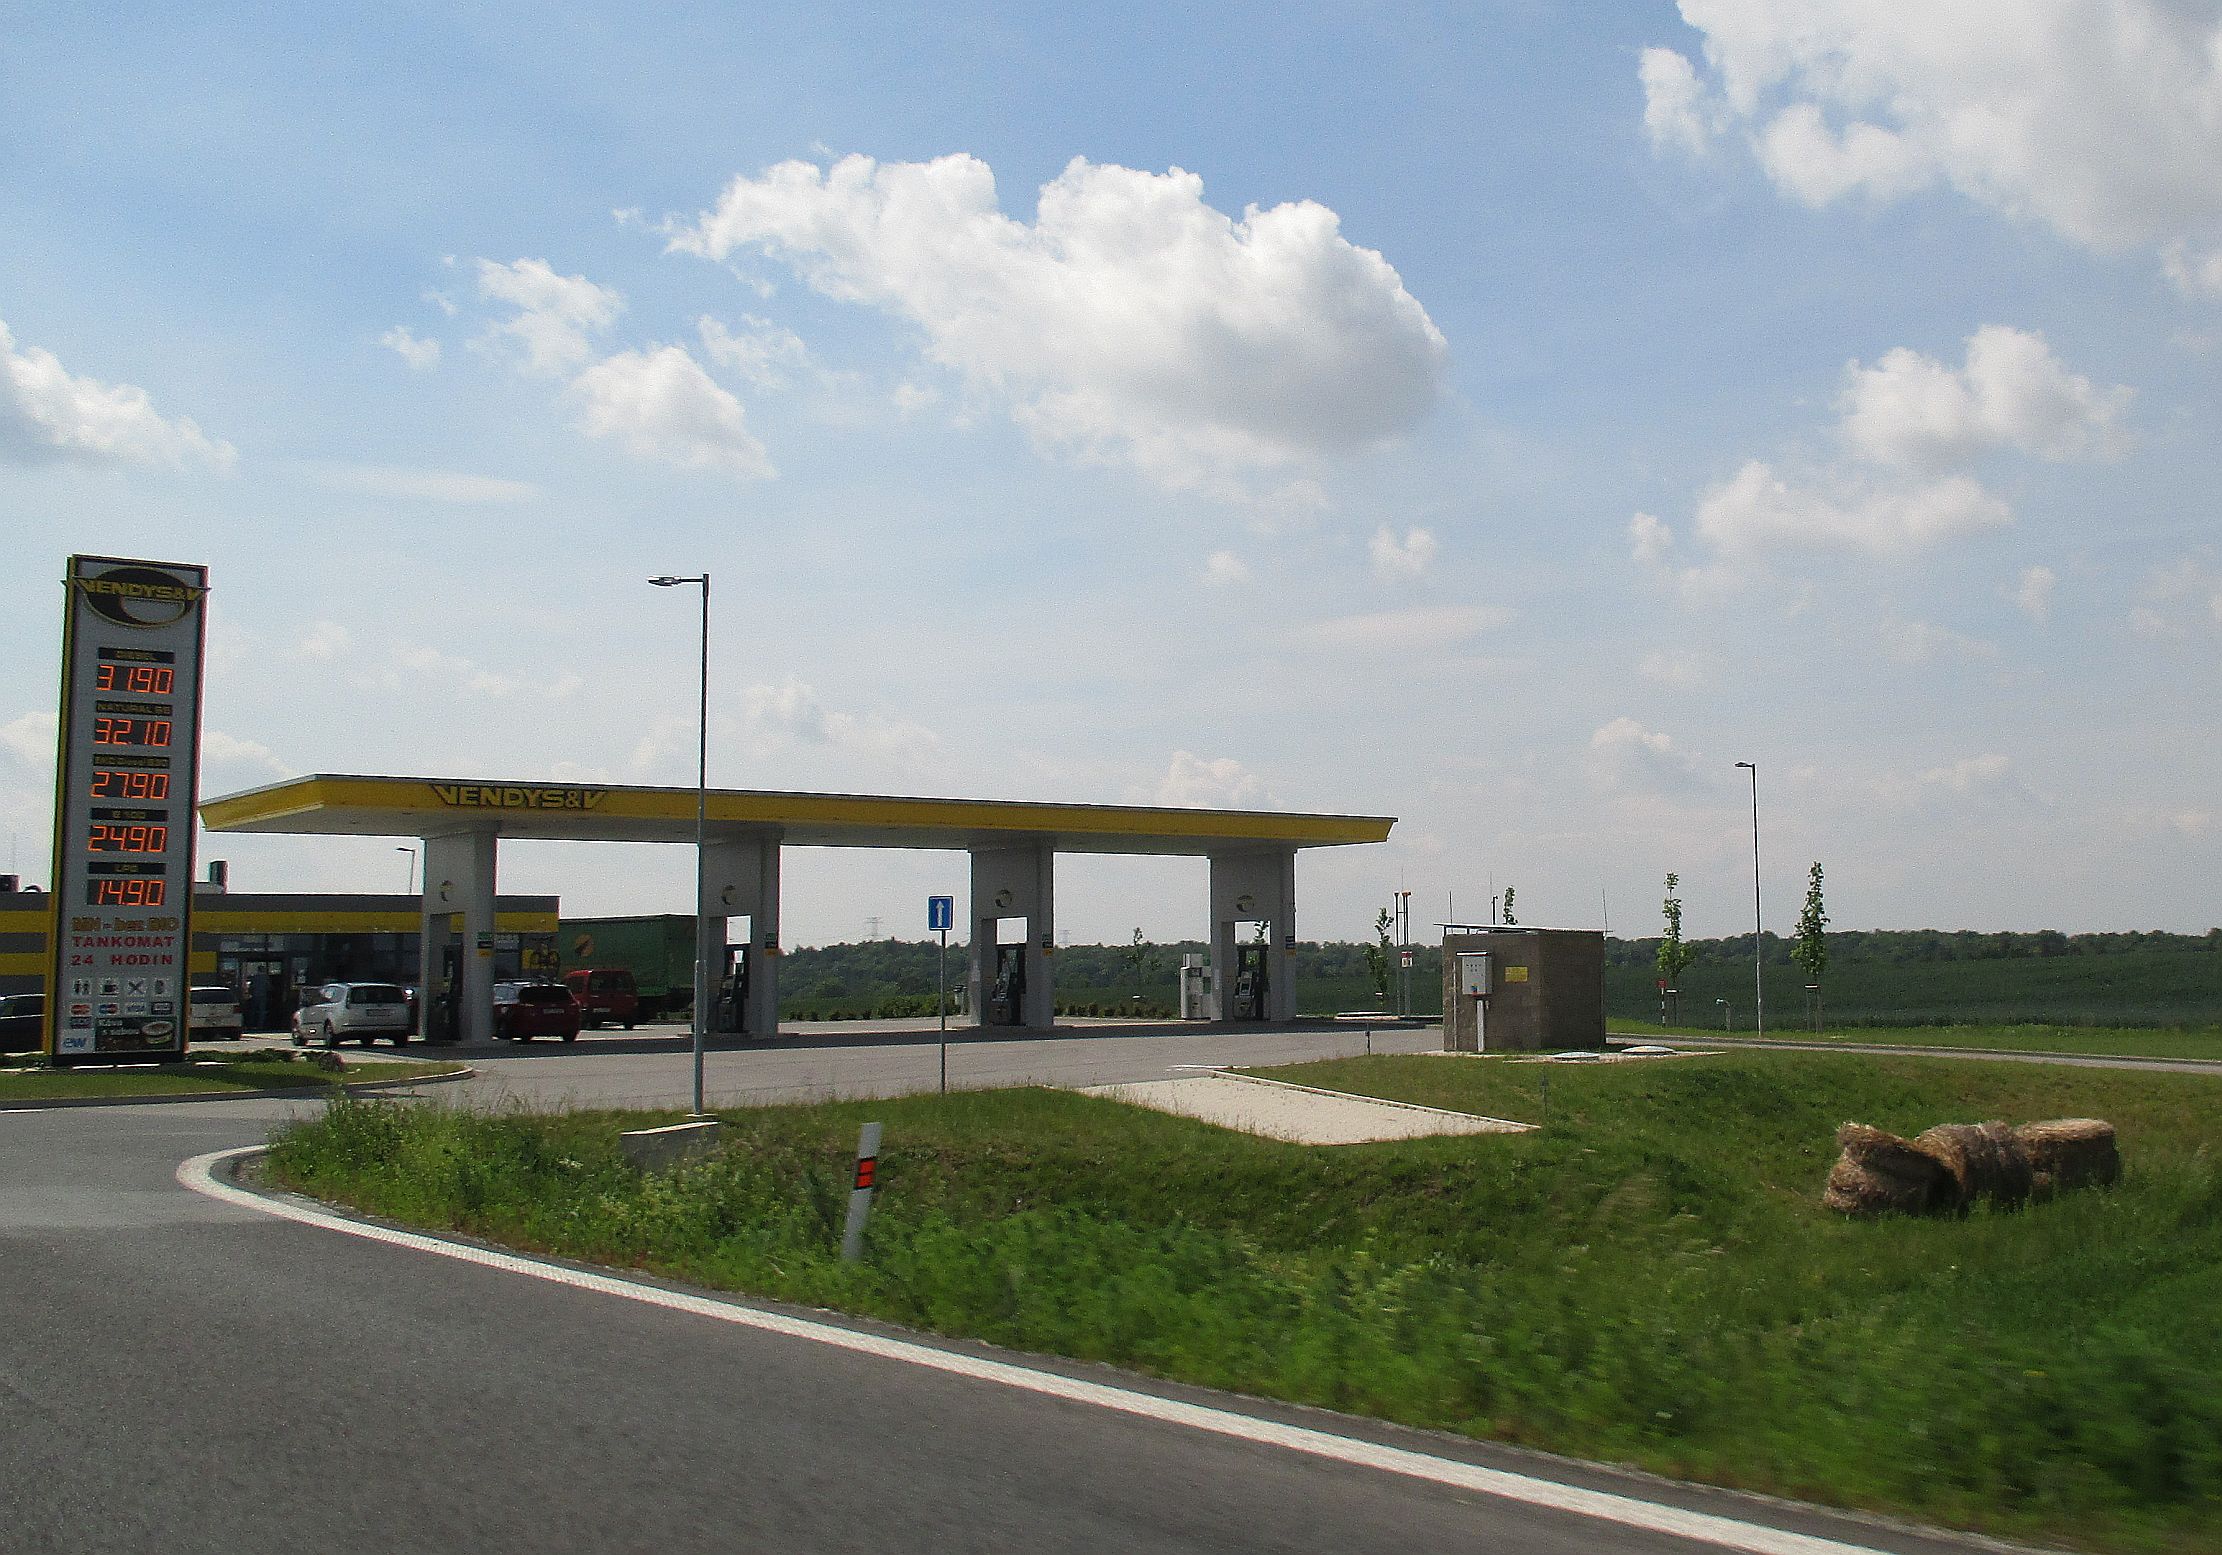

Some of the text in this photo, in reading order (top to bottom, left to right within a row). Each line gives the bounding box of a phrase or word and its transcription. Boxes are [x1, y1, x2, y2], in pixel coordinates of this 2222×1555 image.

[429, 784, 607, 809] VENDYS&V
[71, 936, 175, 947] TANKOMAT
[70, 954, 173, 966] 24 HODIN
